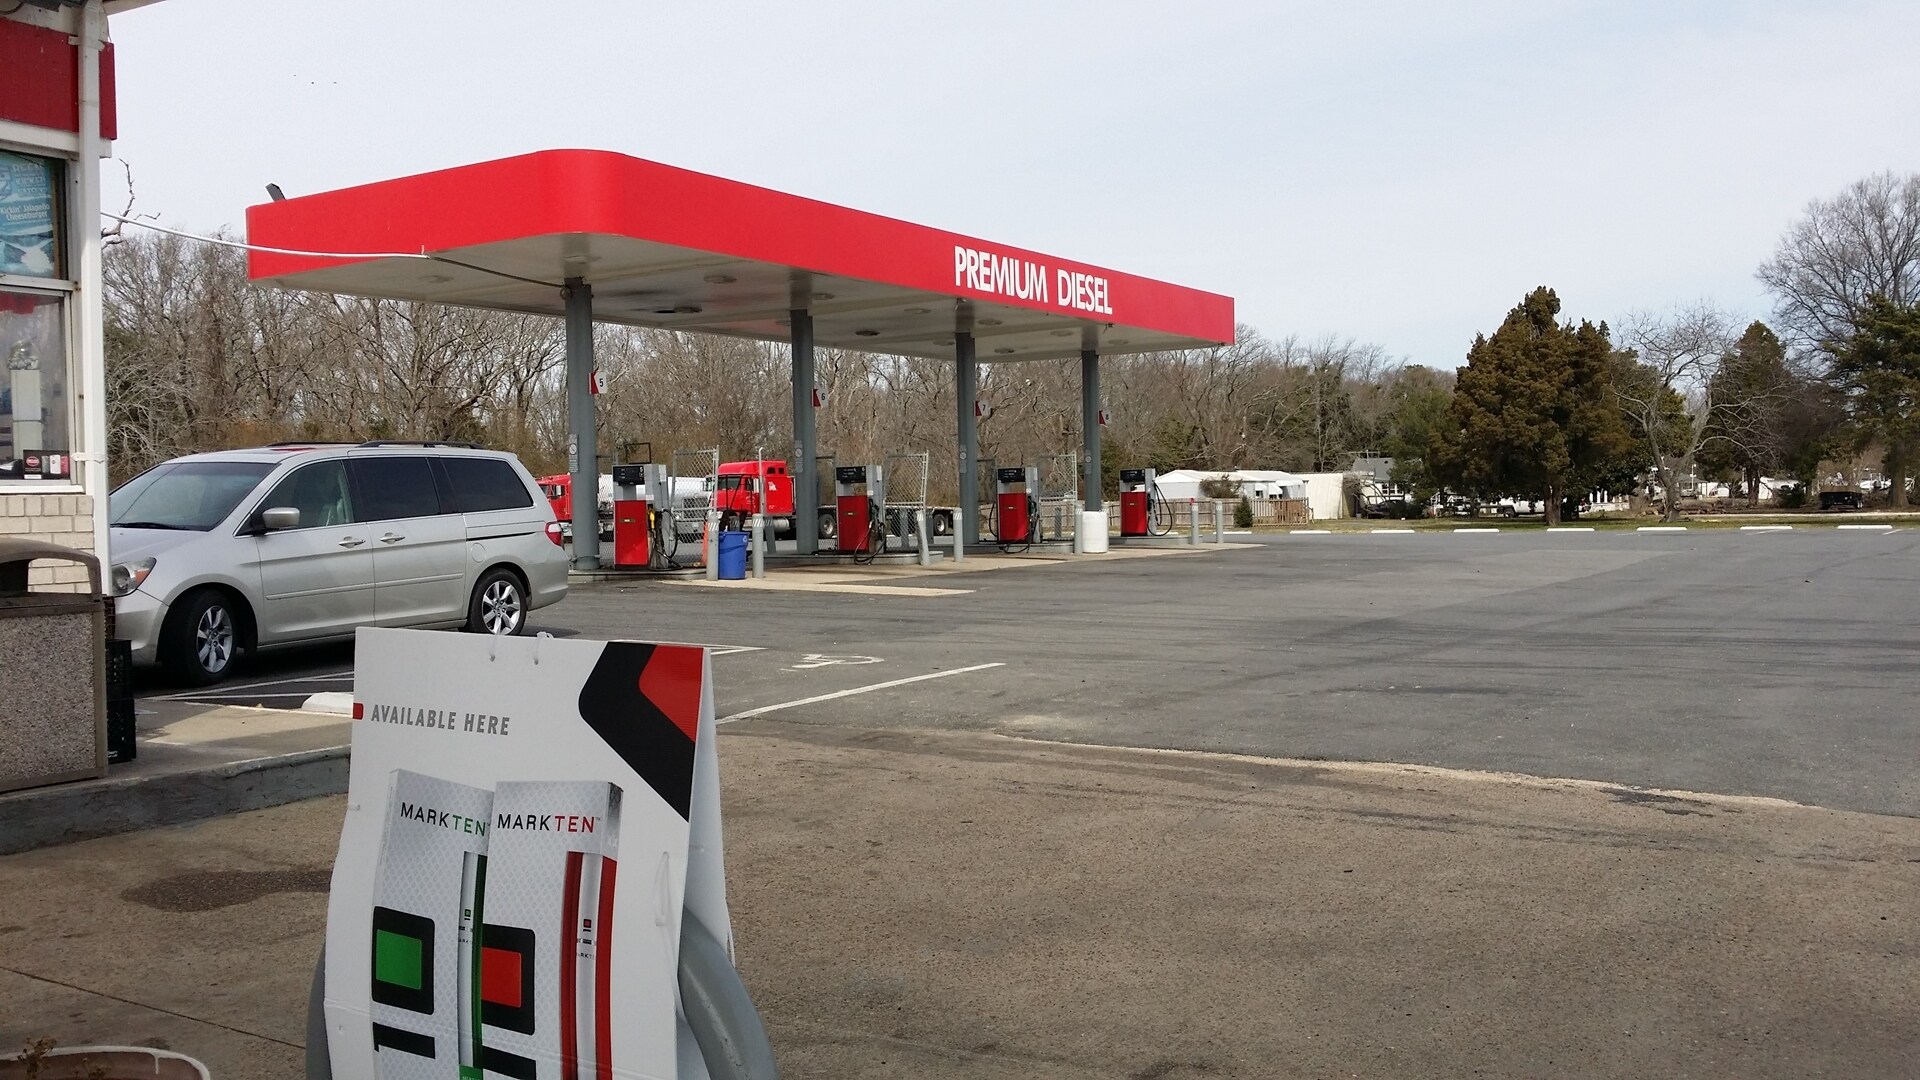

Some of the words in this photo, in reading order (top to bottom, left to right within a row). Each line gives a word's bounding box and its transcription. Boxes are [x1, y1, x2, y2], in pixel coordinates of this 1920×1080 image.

[954, 245, 1048, 303] PREMIUM
[1057, 269, 1113, 314] DIESEL
[599, 378, 604, 387] 5
[821, 393, 826, 401] 6
[371, 704, 457, 730] AVAILABLE
[463, 713, 510, 736] HERE
